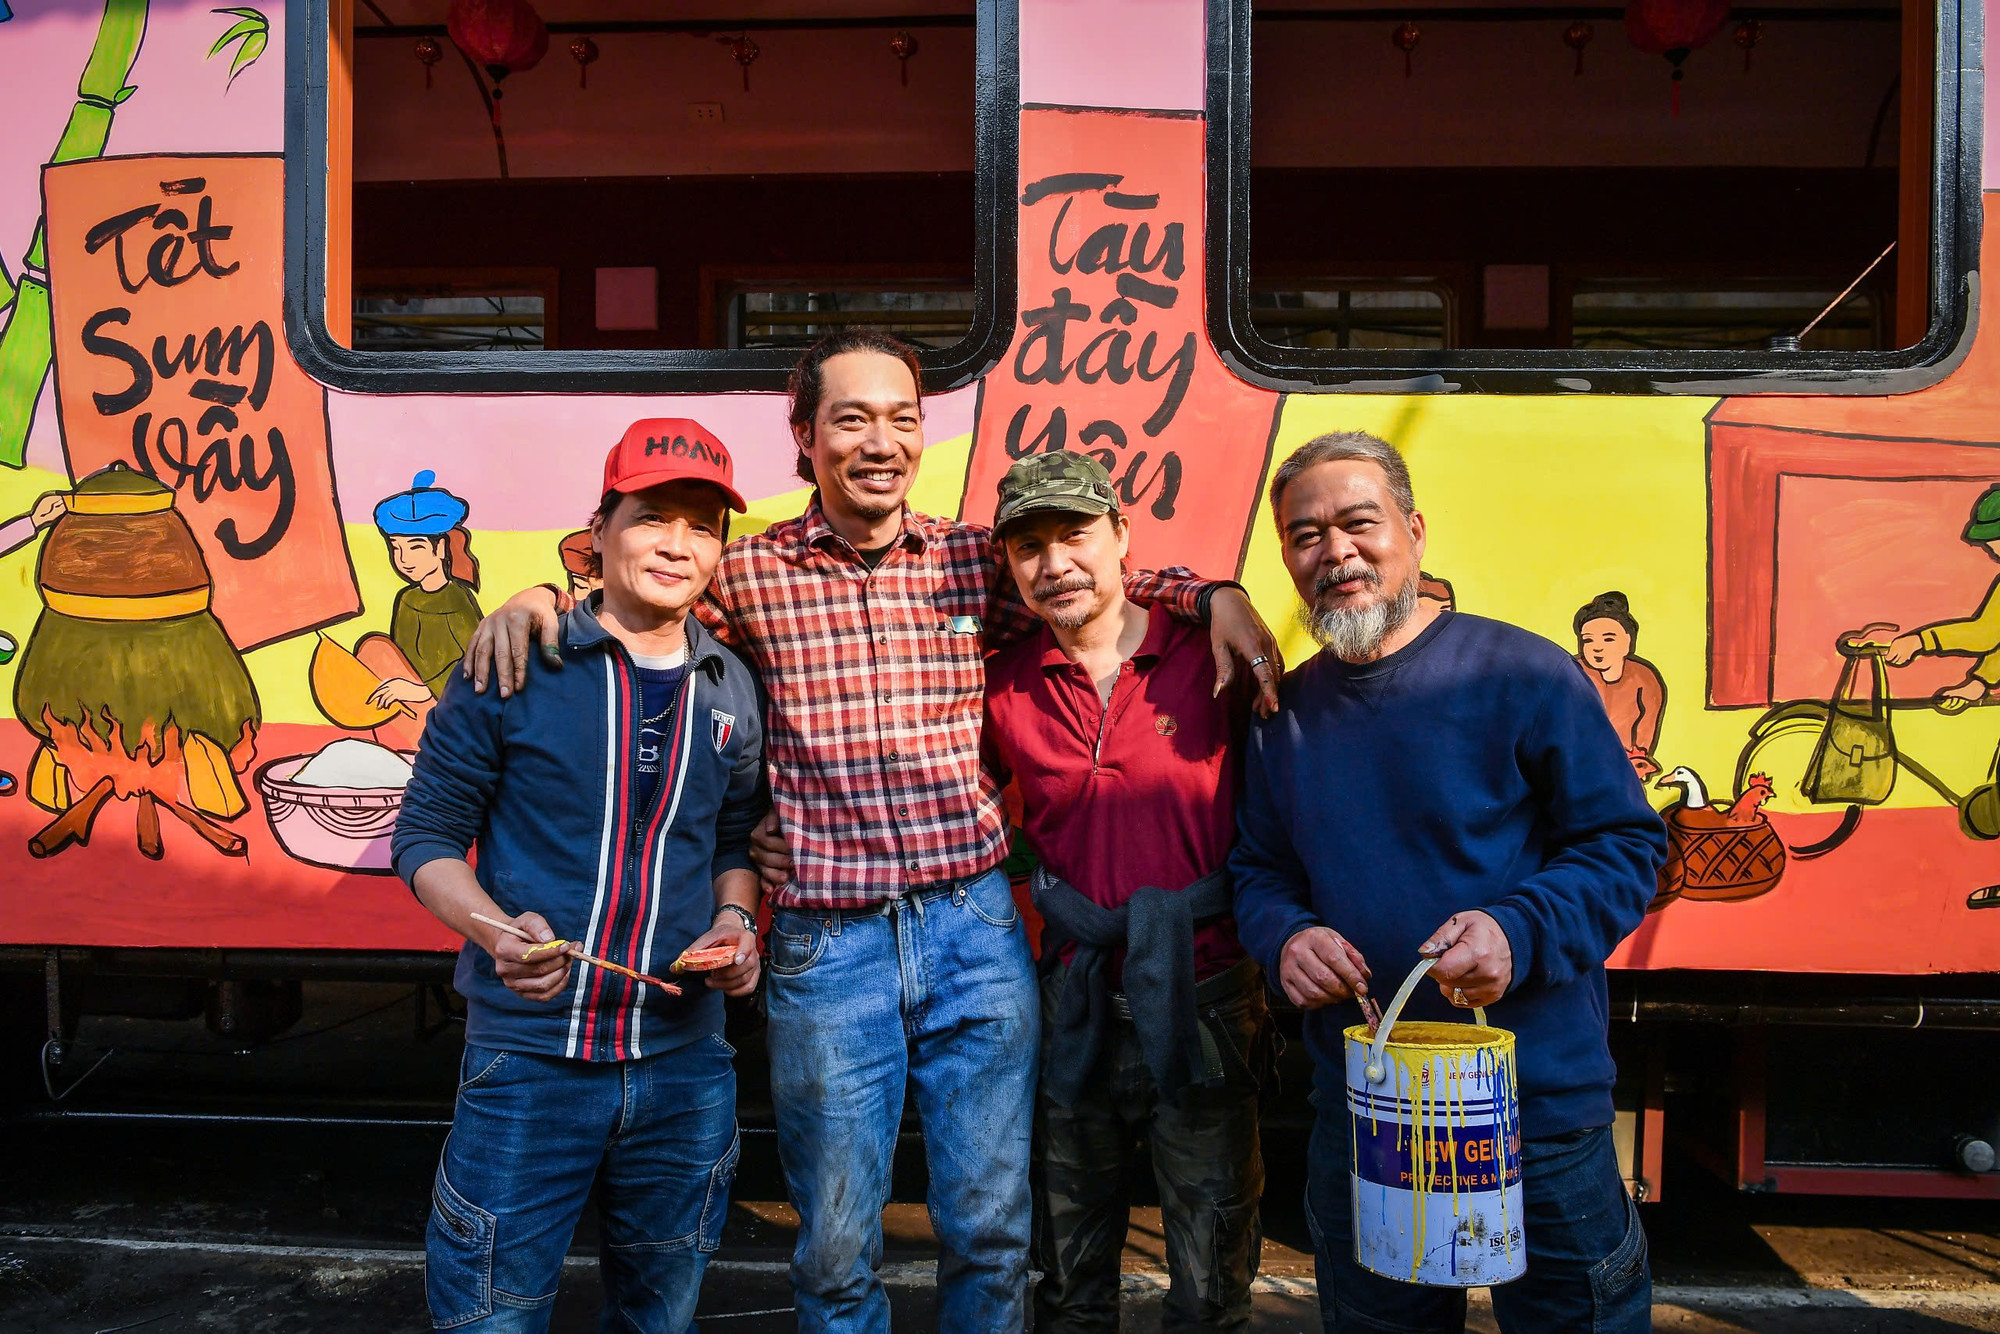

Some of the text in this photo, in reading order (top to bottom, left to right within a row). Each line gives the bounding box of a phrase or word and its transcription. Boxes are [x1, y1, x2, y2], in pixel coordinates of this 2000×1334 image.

[81, 307, 275, 416] Sum
[1480, 1173, 1489, 1185] &
[1489, 1235, 1507, 1248] ISO
